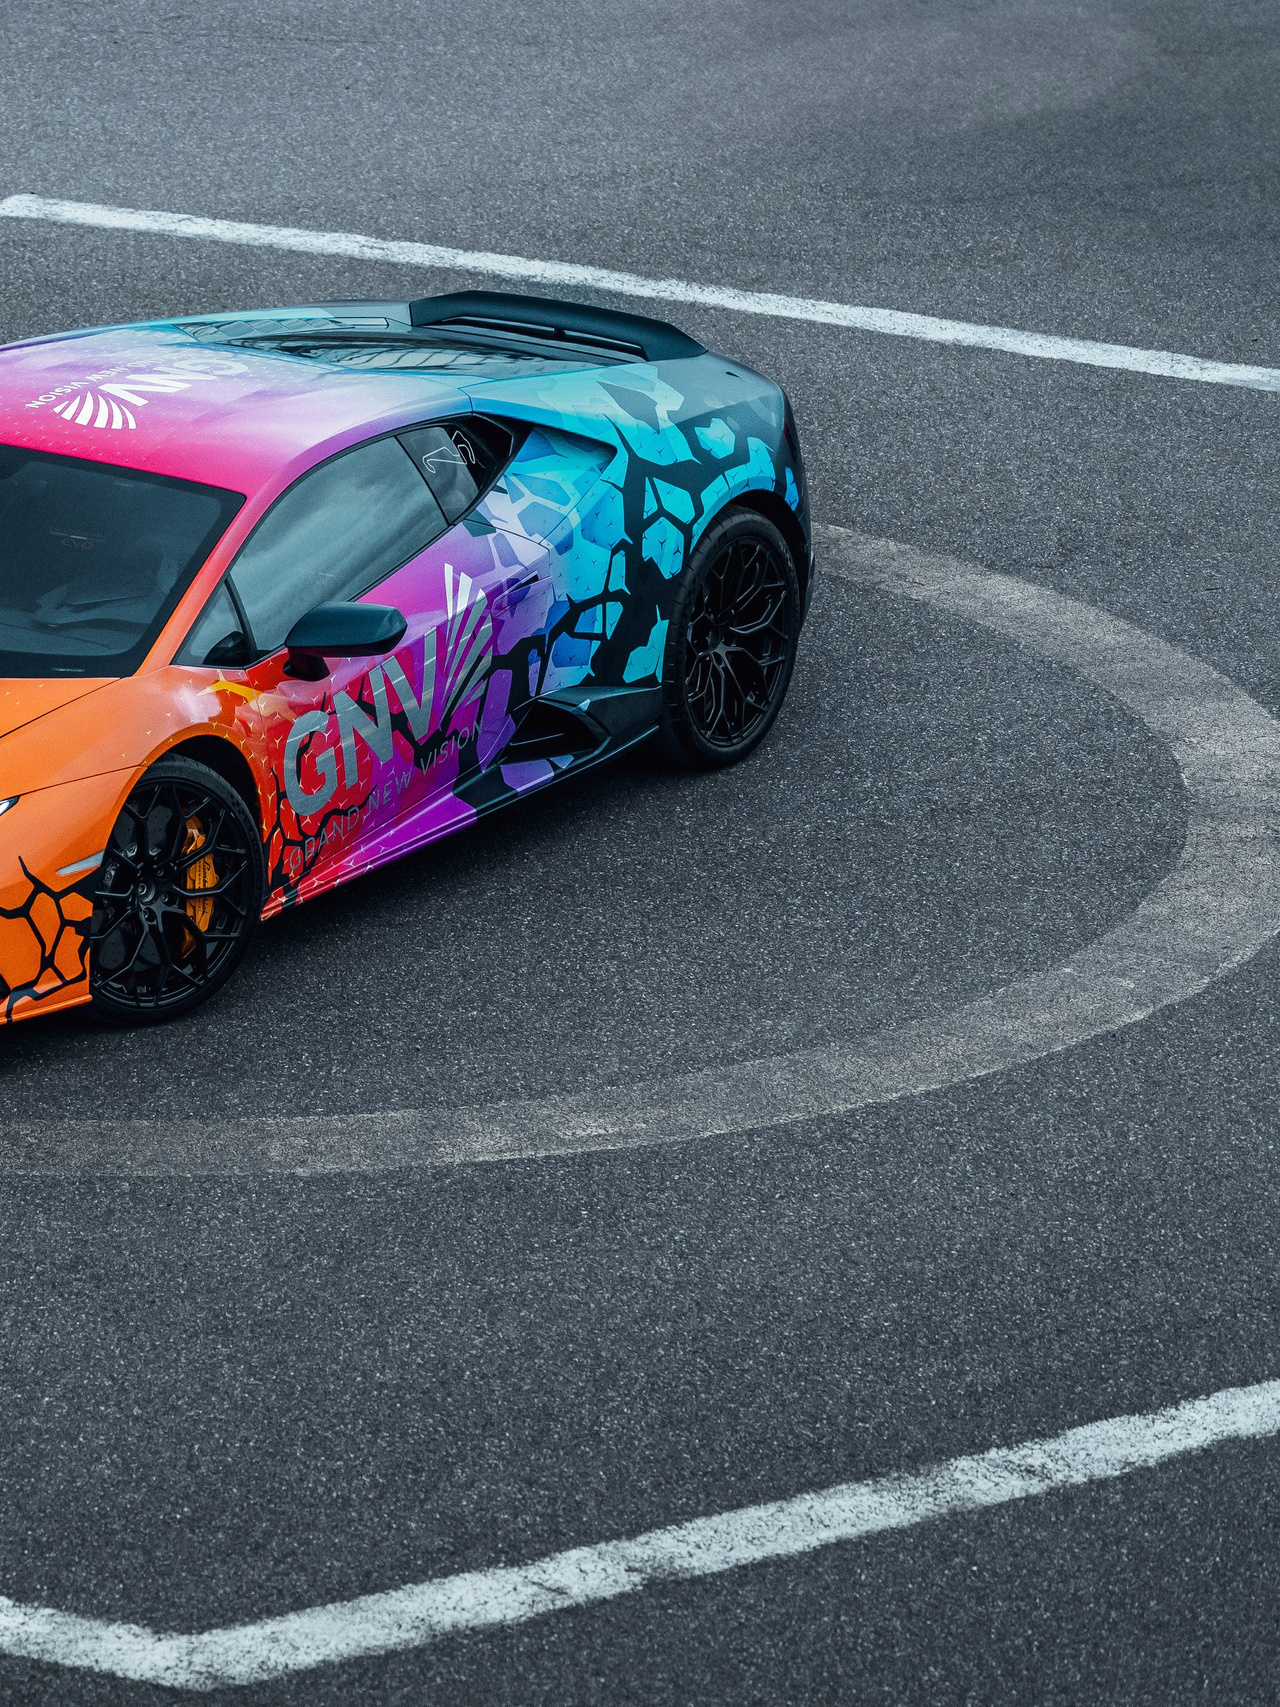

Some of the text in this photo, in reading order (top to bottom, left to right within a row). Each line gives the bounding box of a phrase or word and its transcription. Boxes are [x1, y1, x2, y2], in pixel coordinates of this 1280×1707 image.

[25, 366, 128, 408] NEW VISION
[98, 359, 249, 407] GNV
[283, 626, 438, 817] GNV
[289, 806, 360, 869] GRAND
[368, 766, 413, 810] NEW
[420, 720, 483, 776] VISION
